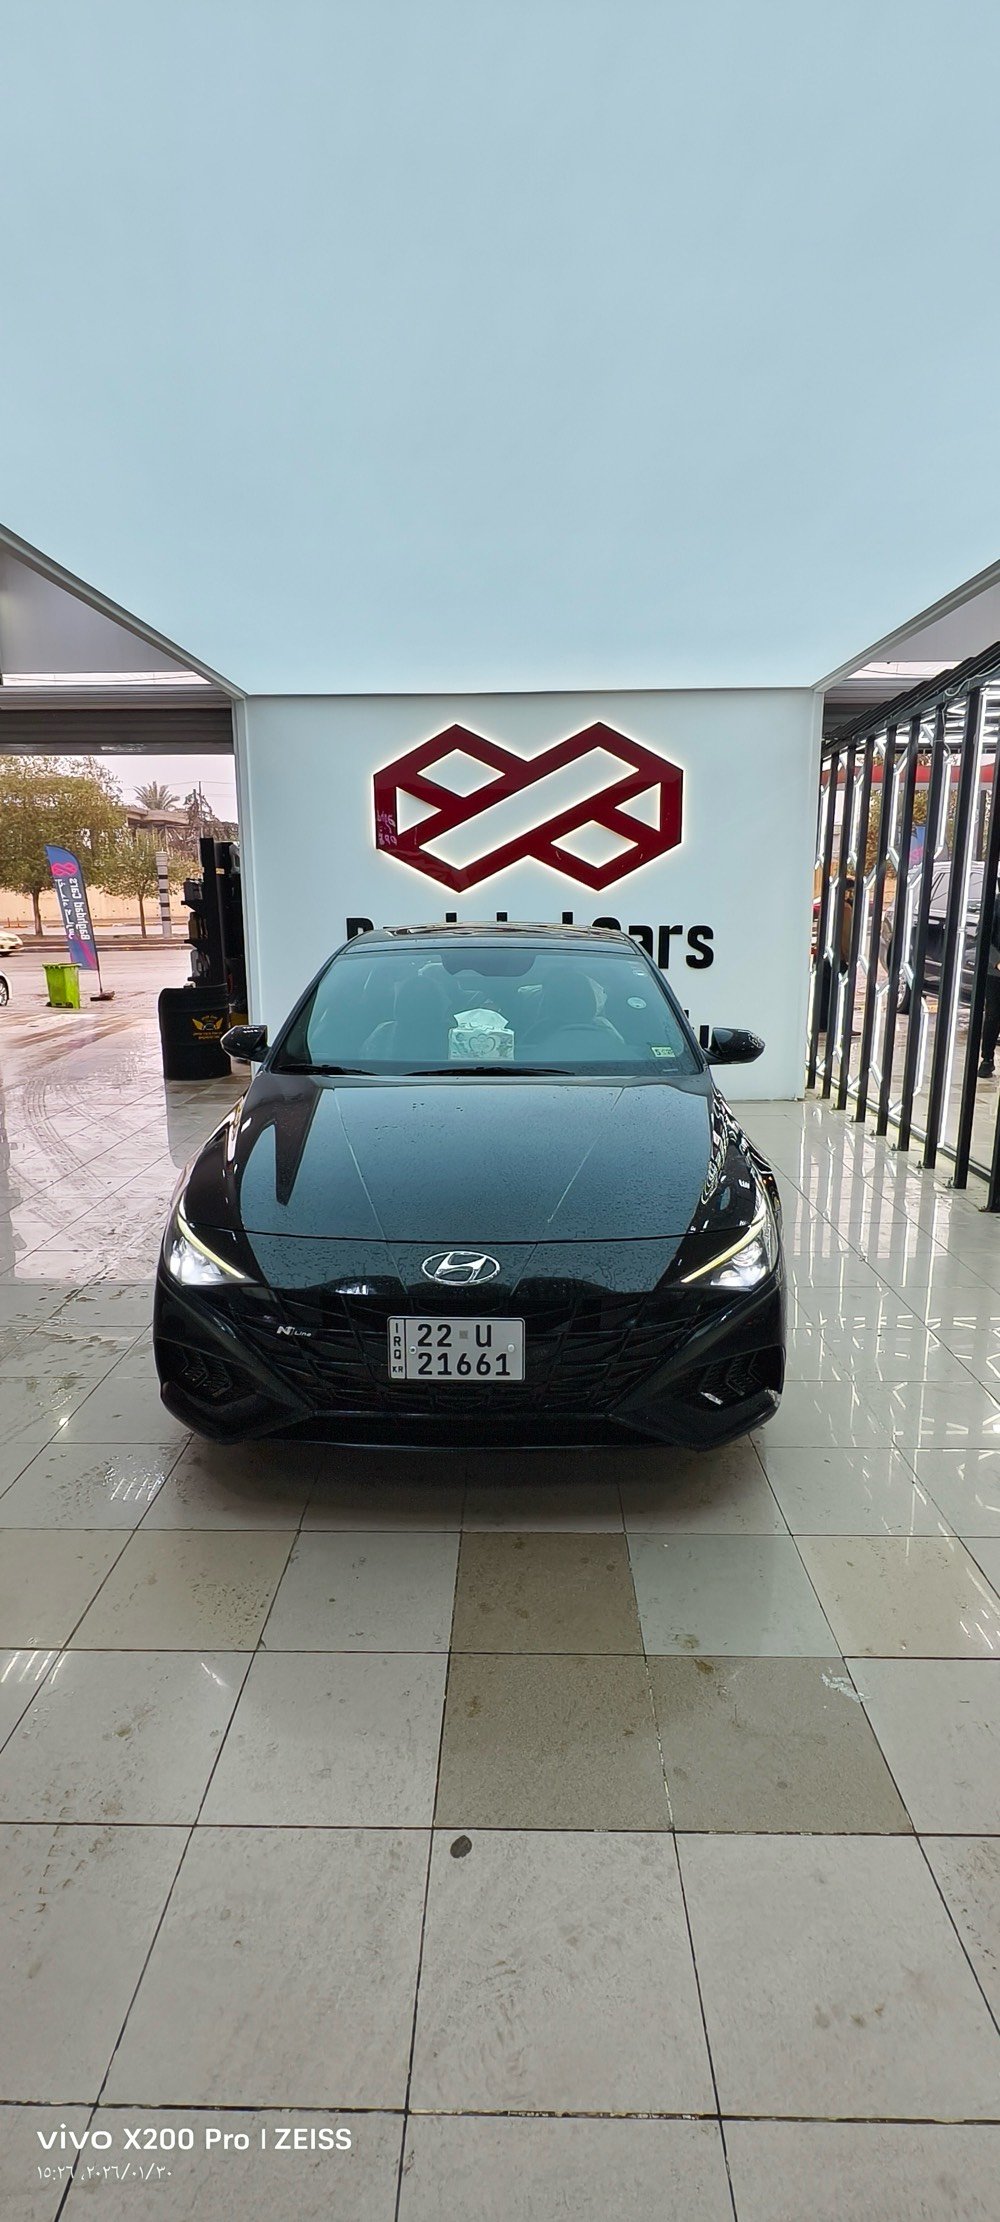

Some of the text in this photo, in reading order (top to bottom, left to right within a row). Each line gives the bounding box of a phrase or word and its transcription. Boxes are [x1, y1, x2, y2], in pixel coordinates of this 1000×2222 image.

[591, 916, 714, 969] ars
[393, 1322, 402, 1361] IRQ
[417, 1323, 492, 1348] 22 U
[392, 1366, 404, 1374] KR
[417, 1352, 511, 1376] 21661
